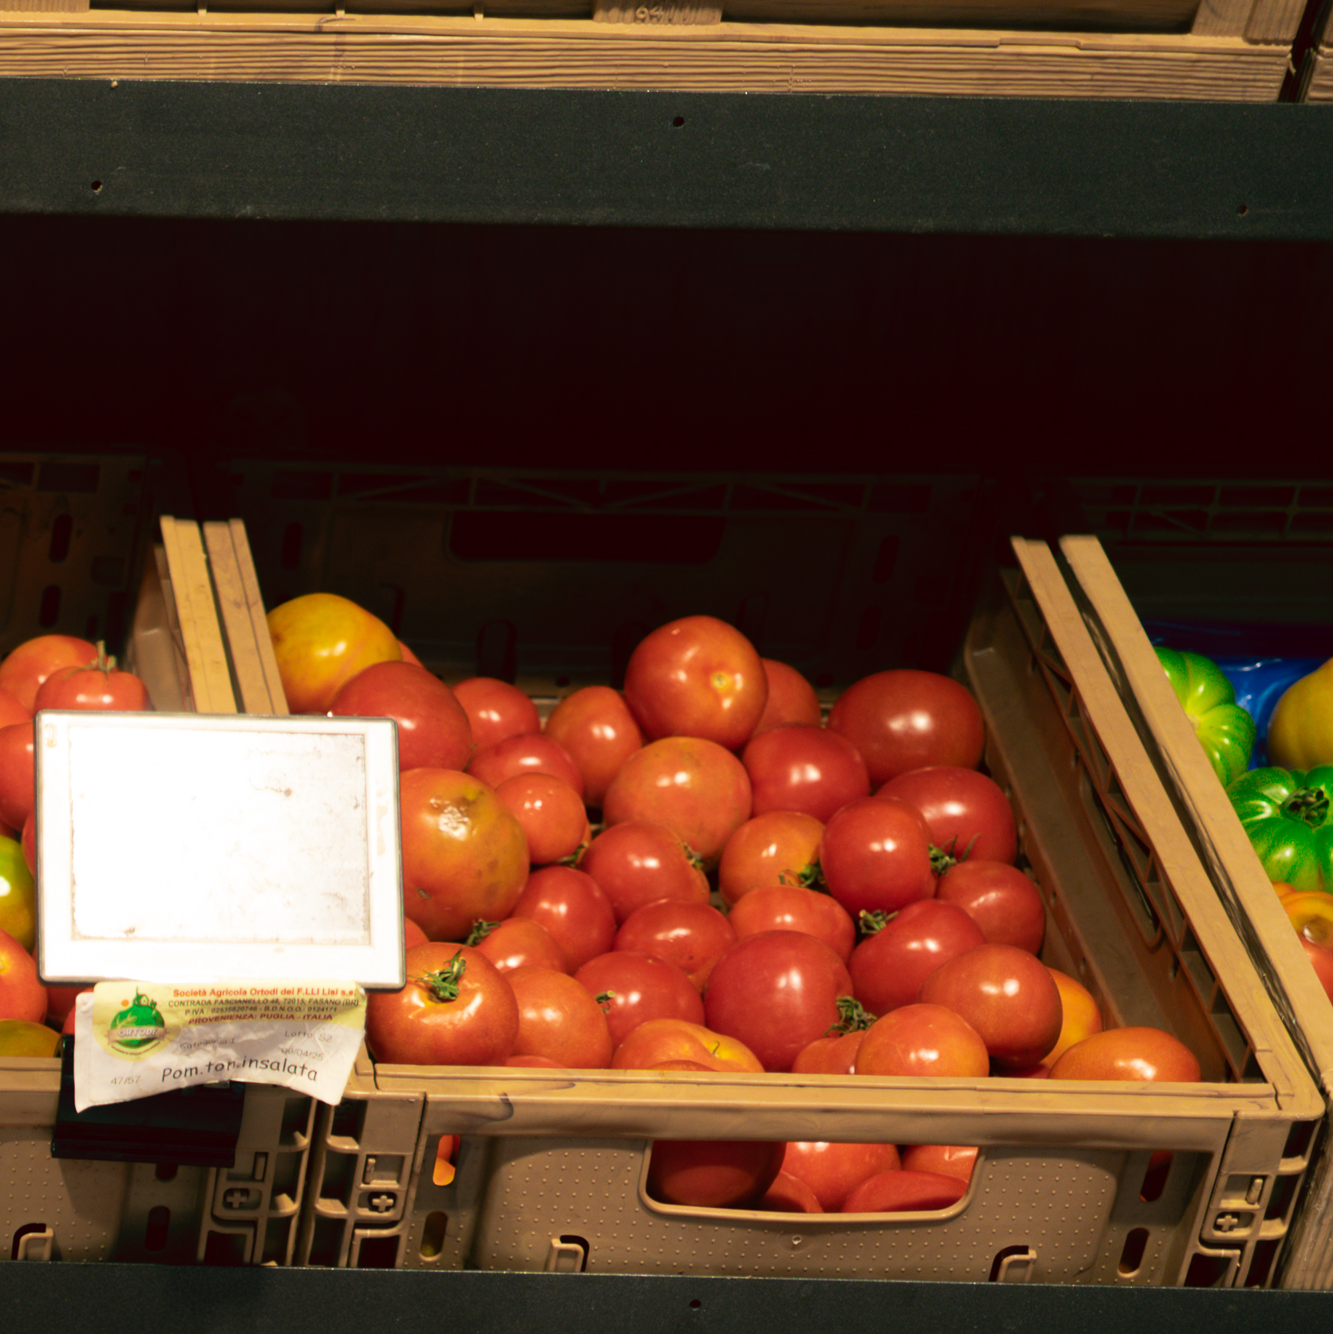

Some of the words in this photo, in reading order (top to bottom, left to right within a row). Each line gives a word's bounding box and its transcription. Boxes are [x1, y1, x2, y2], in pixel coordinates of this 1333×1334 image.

[173, 988, 207, 998] Società
[209, 988, 248, 998] Agricola
[250, 988, 278, 997] Ortodi
[280, 988, 295, 996] dei
[168, 999, 212, 1008] CONTRADA
[308, 999, 341, 1007] FASANO
[188, 1014, 257, 1025] PROVENIENZA:
